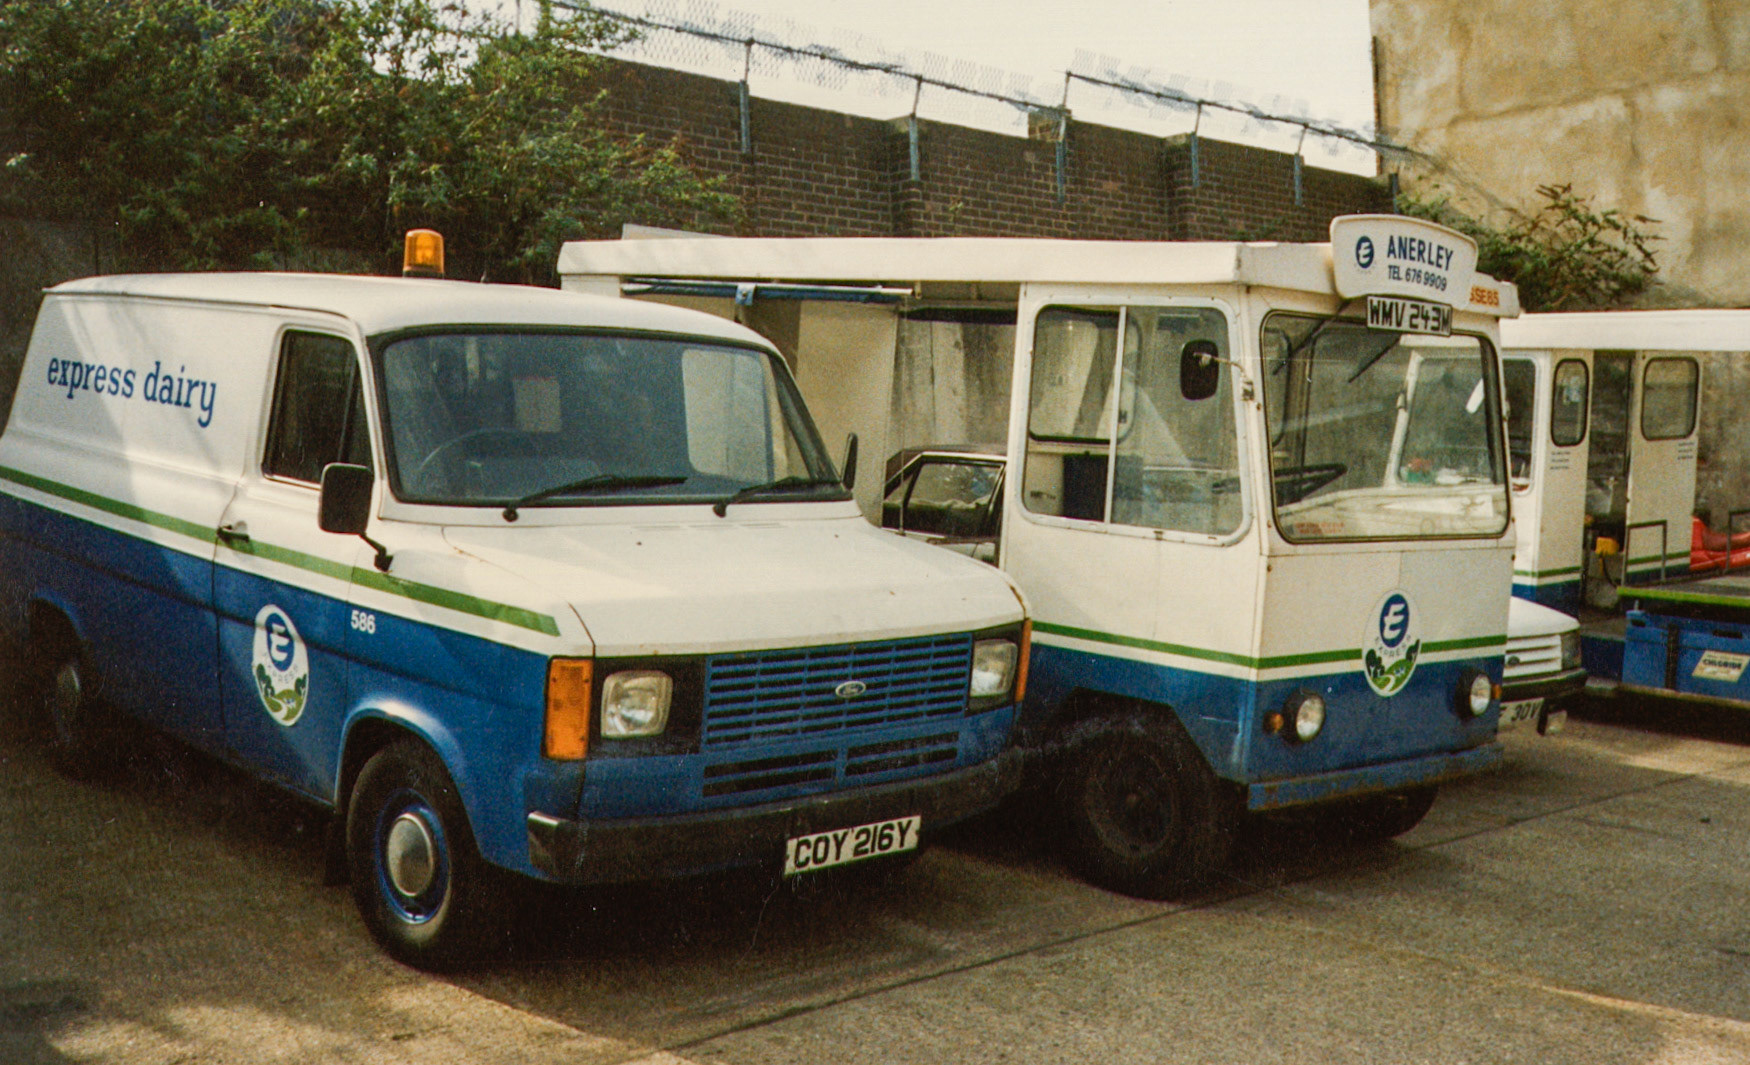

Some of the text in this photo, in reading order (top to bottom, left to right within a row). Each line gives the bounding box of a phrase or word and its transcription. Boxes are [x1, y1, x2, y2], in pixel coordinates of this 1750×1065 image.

[1387, 235, 1453, 271] ANERLEY
[1405, 267, 1422, 284] 676
[1423, 271, 1447, 292] 9909
[1370, 299, 1451, 333] WMV 243M
[47, 357, 216, 428] express dairy
[350, 610, 376, 634] 586
[794, 819, 912, 868] COY 216Y
